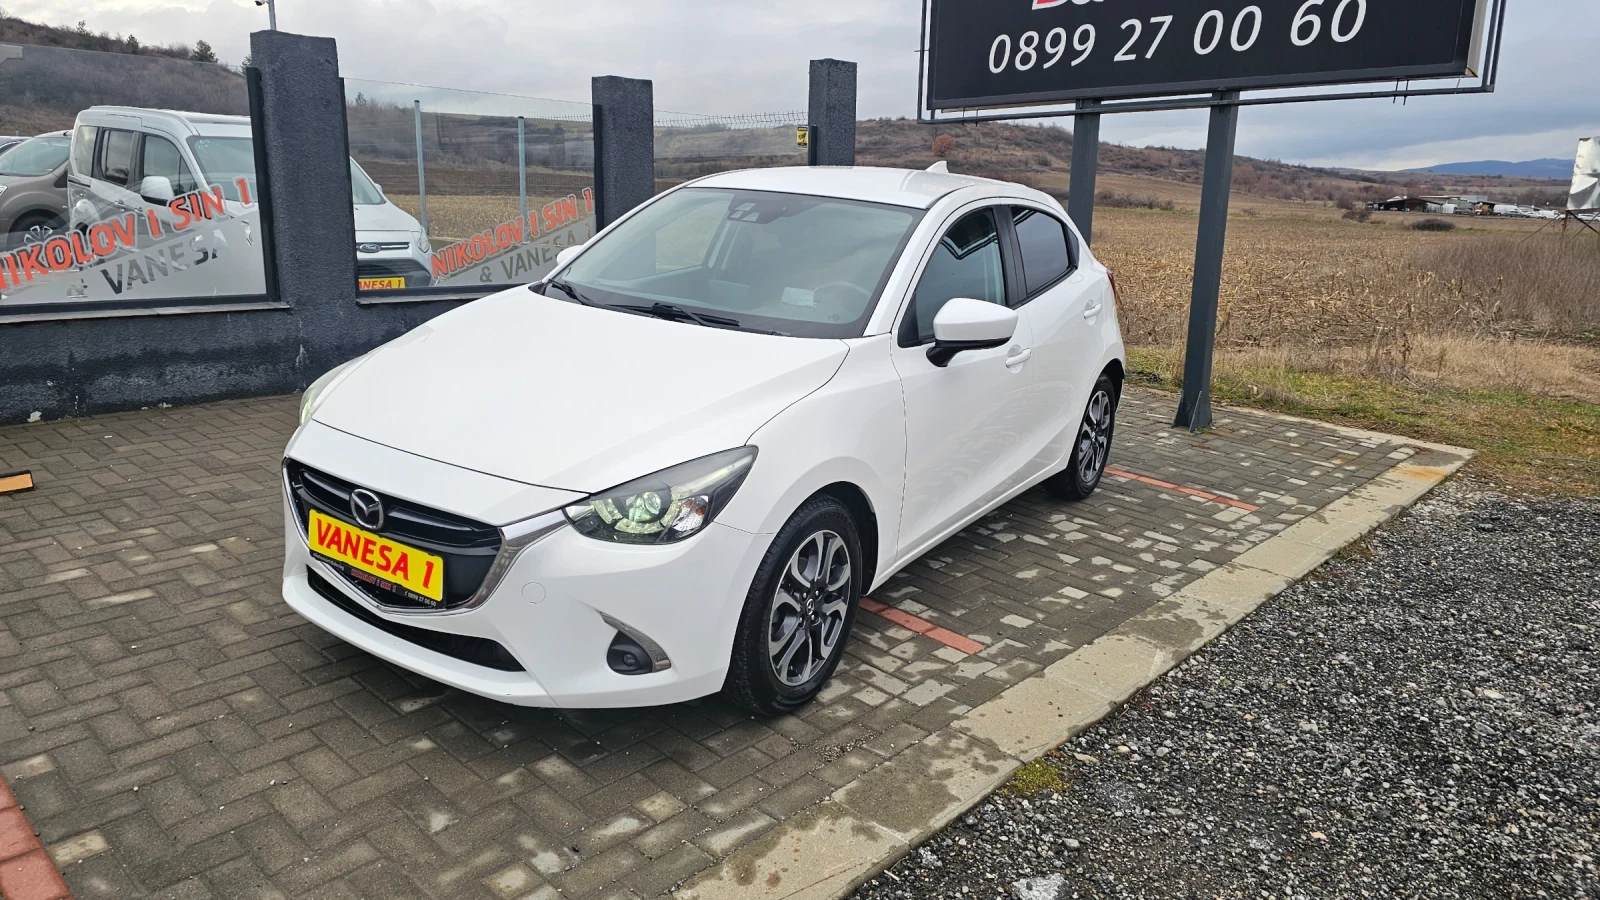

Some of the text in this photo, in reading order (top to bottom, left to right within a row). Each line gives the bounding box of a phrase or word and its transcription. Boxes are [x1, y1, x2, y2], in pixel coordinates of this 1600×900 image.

[988, 0, 1367, 74] 0899 27 00 60
[169, 186, 226, 230] SIN
[431, 217, 523, 278] NIKOLOV
[543, 195, 577, 230] SIN
[480, 266, 492, 282] &
[317, 518, 409, 581] VANESA
[423, 561, 434, 589] 1
